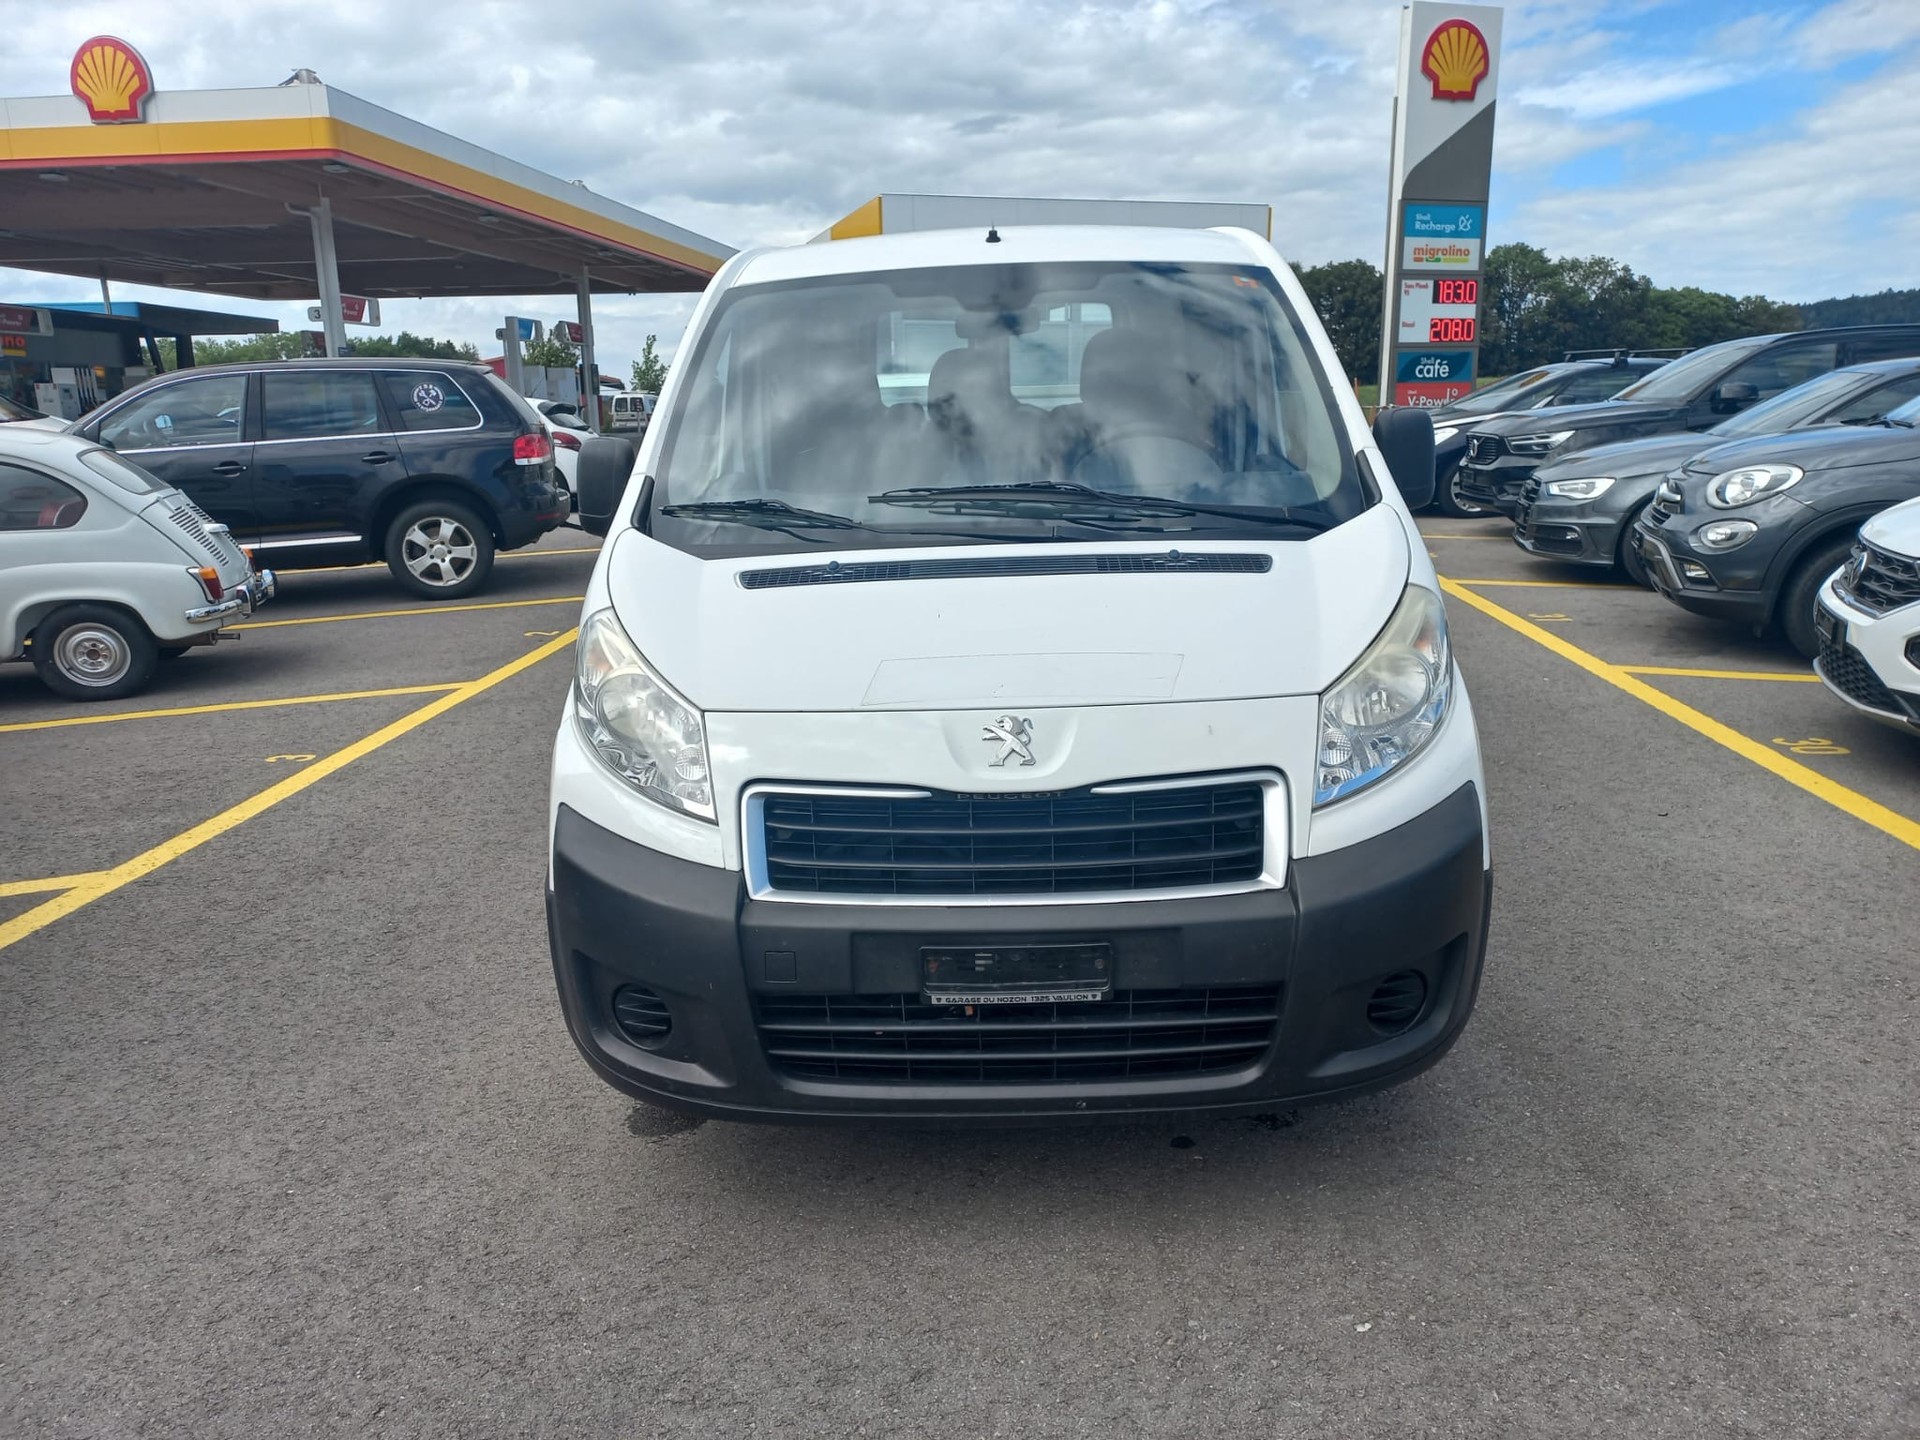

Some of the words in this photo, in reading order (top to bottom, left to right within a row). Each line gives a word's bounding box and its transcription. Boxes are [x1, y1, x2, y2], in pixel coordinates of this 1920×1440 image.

[1415, 221, 1456, 233] Recharge
[1413, 243, 1471, 260] migrolino
[314, 309, 321, 319] 3
[1421, 356, 1435, 365] Shell
[1415, 358, 1450, 378] café
[957, 792, 1065, 800] PEUGEOT
[1052, 993, 1089, 1001] VAULION
